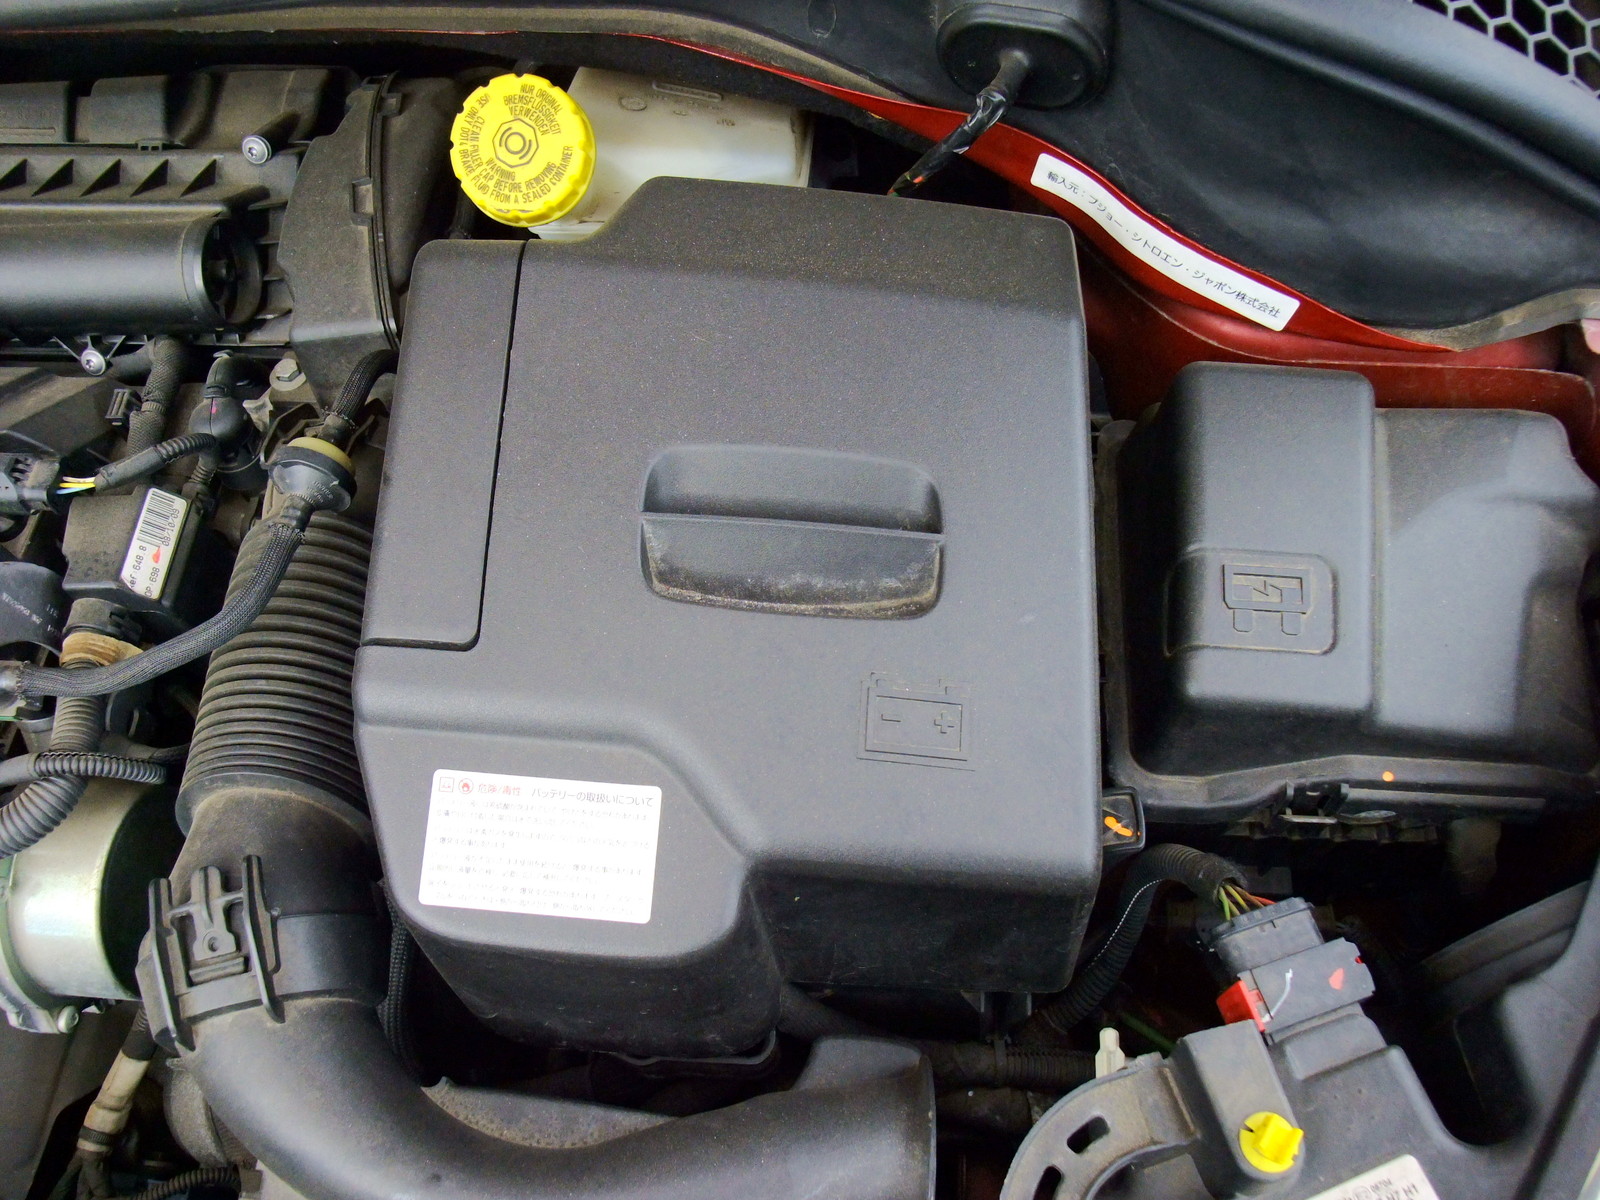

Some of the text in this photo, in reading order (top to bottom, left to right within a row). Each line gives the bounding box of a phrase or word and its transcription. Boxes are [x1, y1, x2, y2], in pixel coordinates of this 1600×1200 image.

[476, 93, 490, 108] USE
[520, 83, 563, 115] NUR ORIGINAL
[464, 106, 479, 126] ONLY
[508, 105, 551, 136] VERWENDEN
[459, 148, 475, 177] BRAKE
[469, 115, 557, 193] CLEAN FILLER CAP BEFORE REMOVING
[485, 157, 516, 182] WARNING
[549, 145, 574, 186] CONTAINER
[471, 174, 490, 195] FLUID
[521, 182, 551, 204] SEALED
[490, 188, 511, 204] FROM
[513, 194, 519, 204] A
[532, 787, 654, 808] バッテリーの取扱いについて
